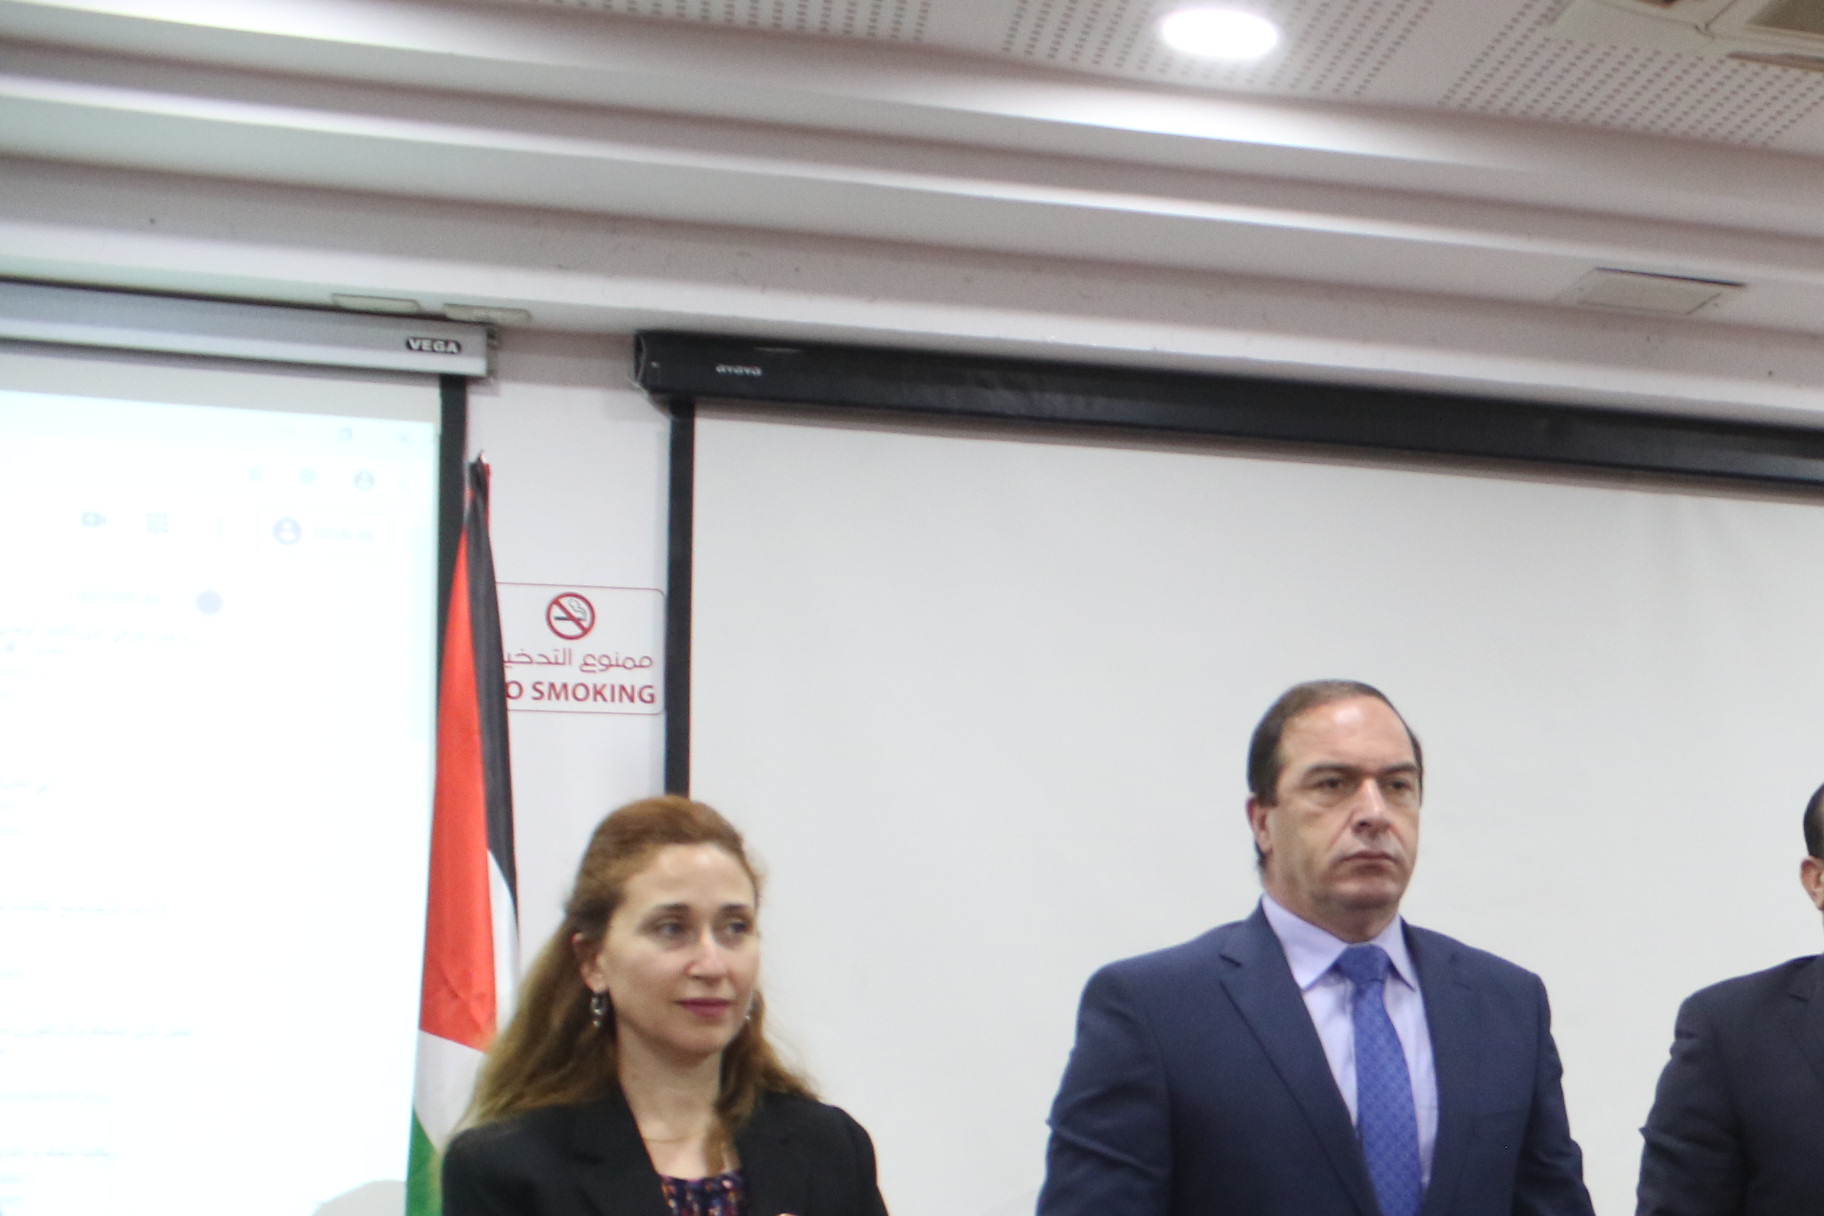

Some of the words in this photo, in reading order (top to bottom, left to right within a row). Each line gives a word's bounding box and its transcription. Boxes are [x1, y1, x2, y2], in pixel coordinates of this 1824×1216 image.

[409, 338, 458, 353] VEGA
[504, 648, 572, 668] التدخي
[579, 651, 653, 673] ممنوع
[531, 681, 656, 704] SMOKING
